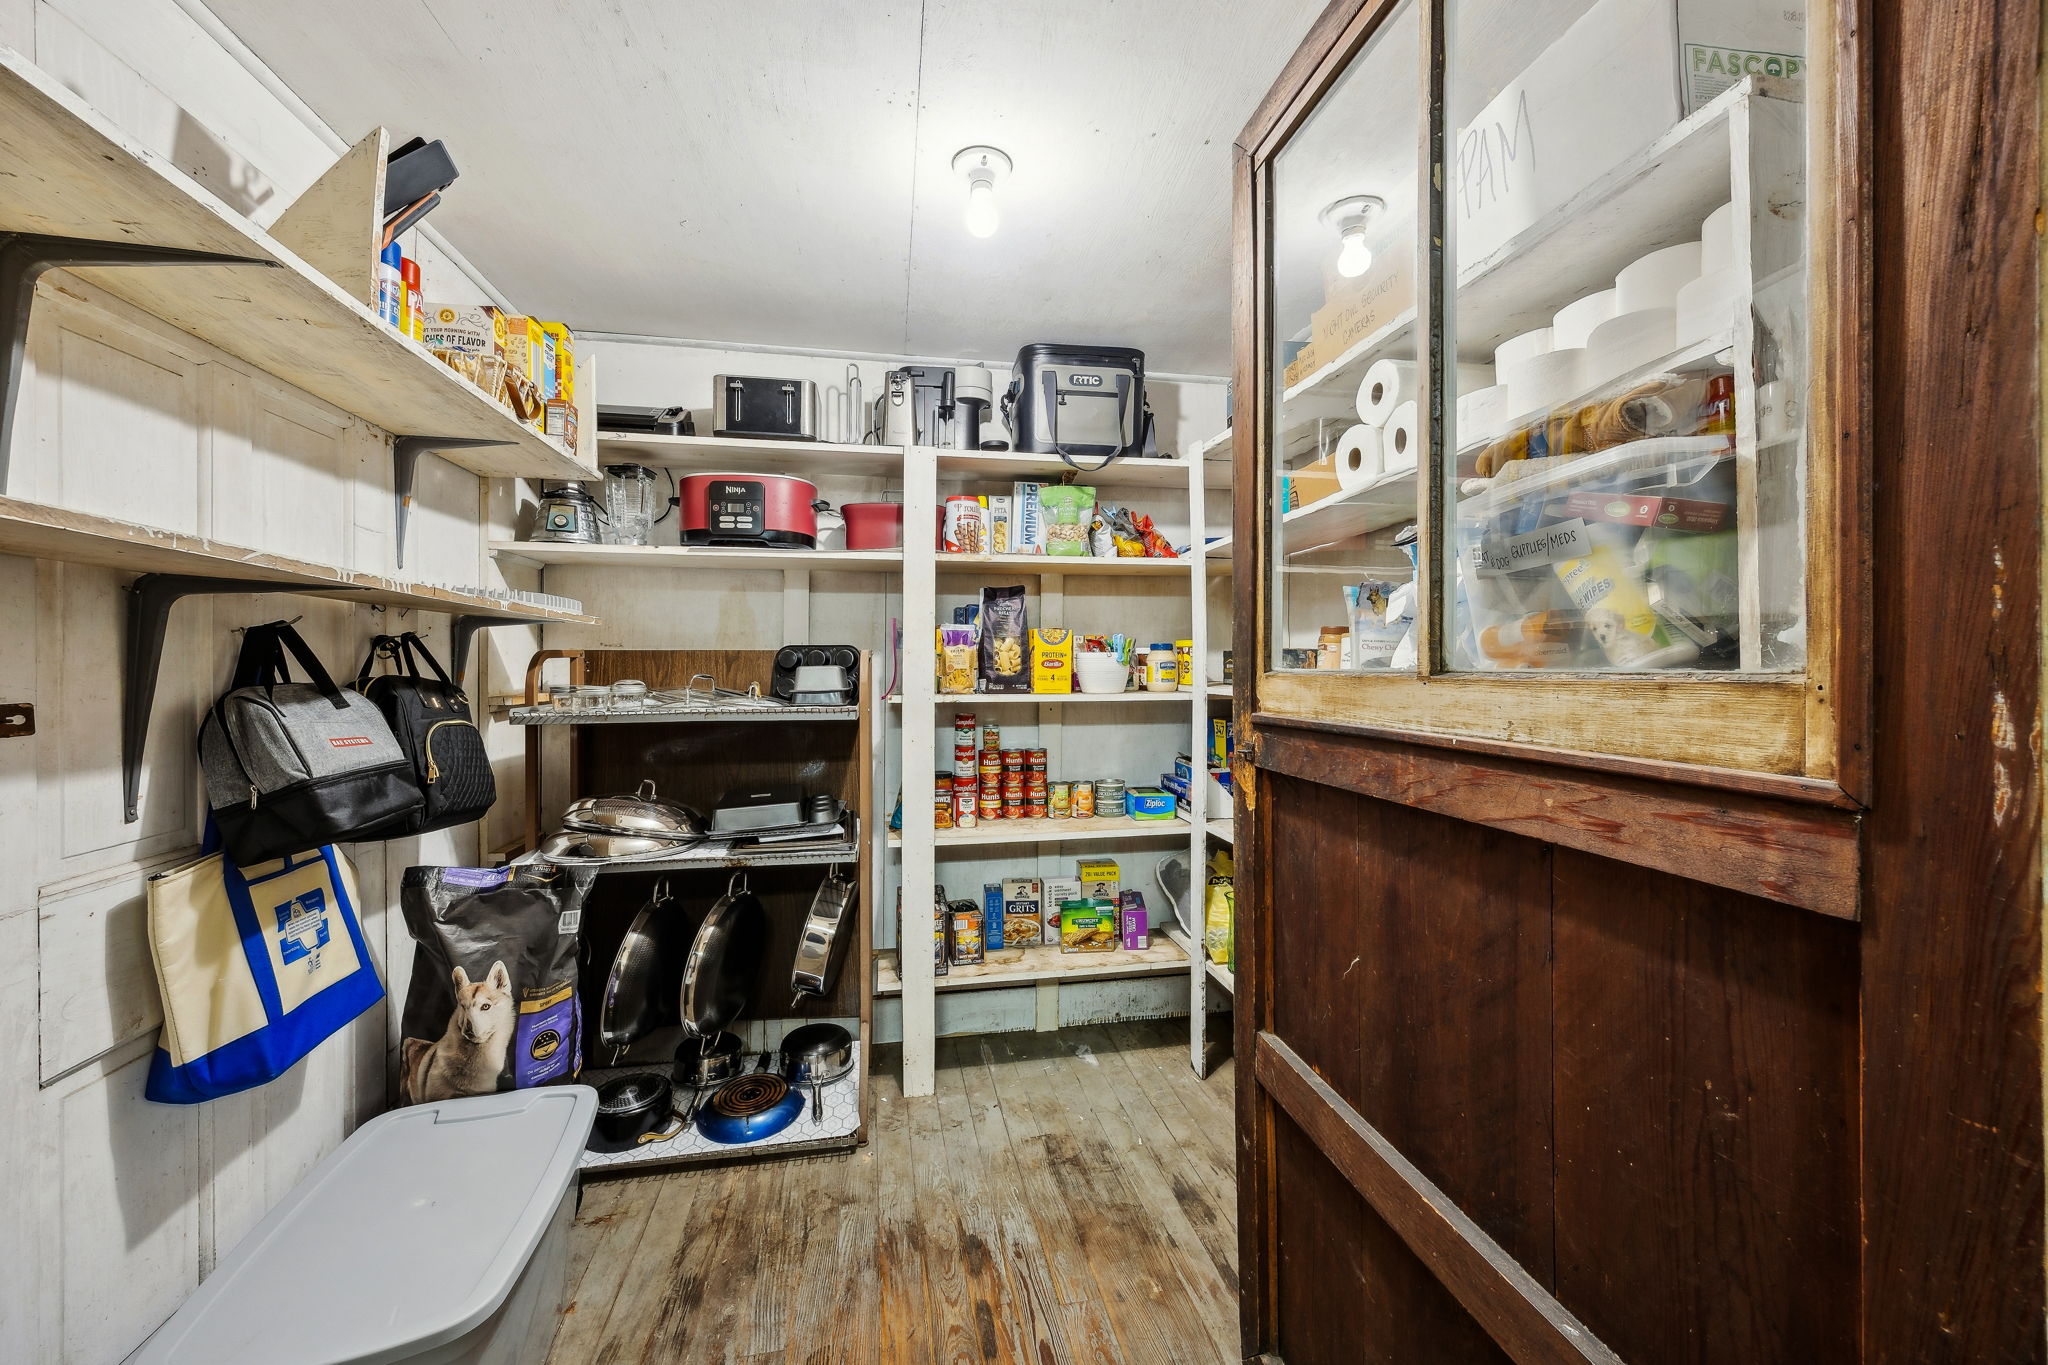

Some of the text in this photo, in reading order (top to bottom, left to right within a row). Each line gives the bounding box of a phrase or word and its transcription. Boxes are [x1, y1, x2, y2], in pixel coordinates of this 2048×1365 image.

[1692, 47, 1806, 79] FASCOP
[1457, 89, 1536, 219] PAM
[446, 335, 456, 344] OF
[457, 335, 487, 347] FLAVOR
[1073, 375, 1100, 386] RTIC
[725, 485, 746, 494] NINJA
[1024, 483, 1038, 545] PREMIUM
[1496, 556, 1510, 570] DOG
[1583, 578, 1611, 604] WIPES
[1361, 643, 1384, 651] Chewy
[1145, 799, 1166, 808] Ziploc
[1008, 904, 1036, 913] GRITS
